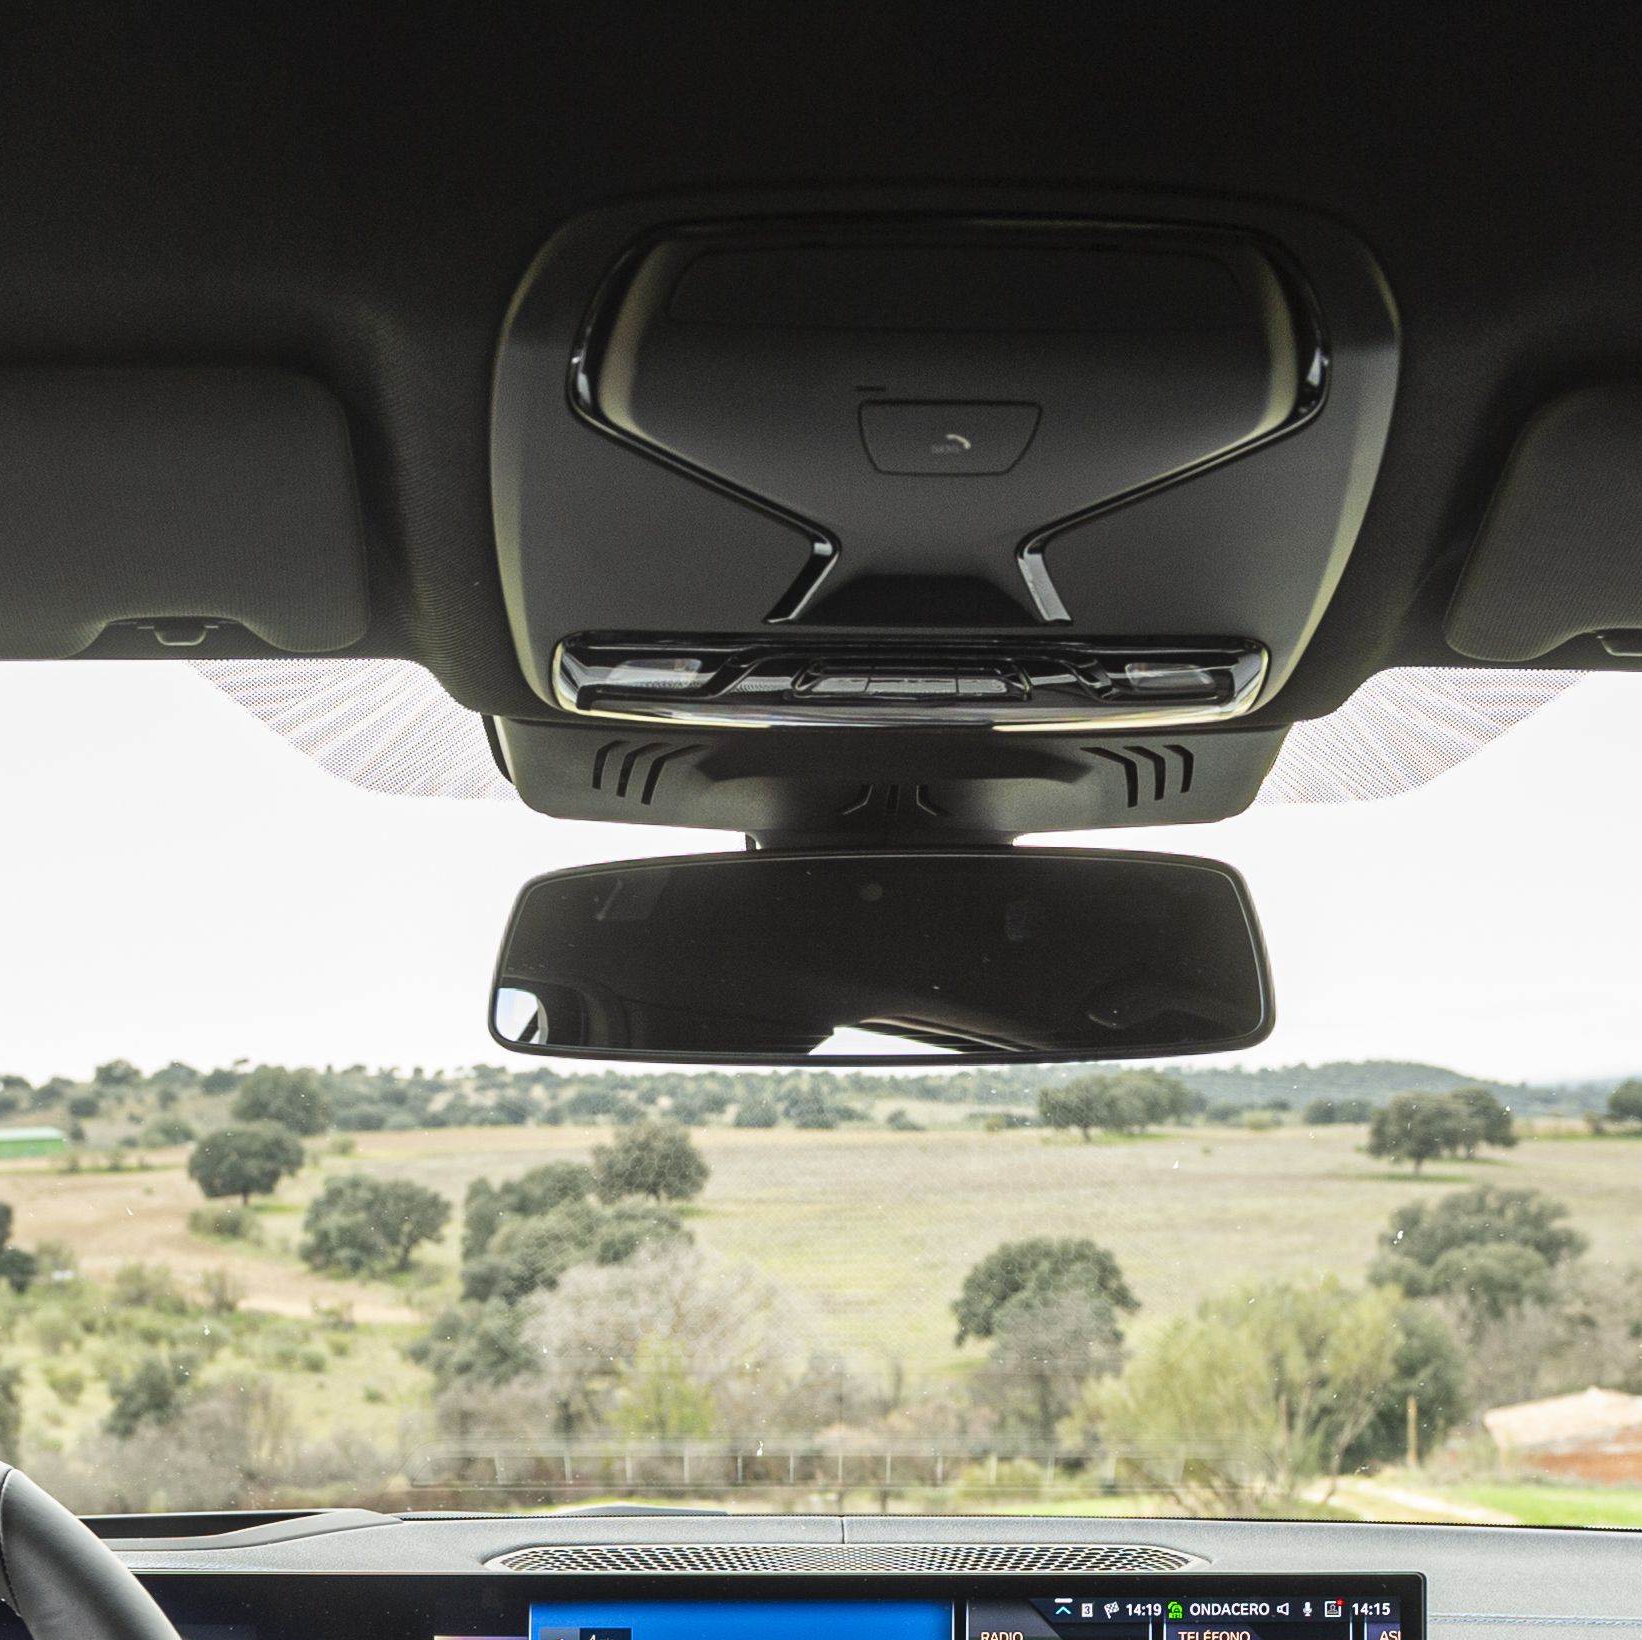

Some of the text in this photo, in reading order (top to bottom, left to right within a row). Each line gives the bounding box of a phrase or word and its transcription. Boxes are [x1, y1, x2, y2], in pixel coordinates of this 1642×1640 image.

[1125, 1602, 1162, 1617] 14:19
[1189, 1603, 1270, 1617] ONDACERO
[1351, 1602, 1391, 1616] 14:15
